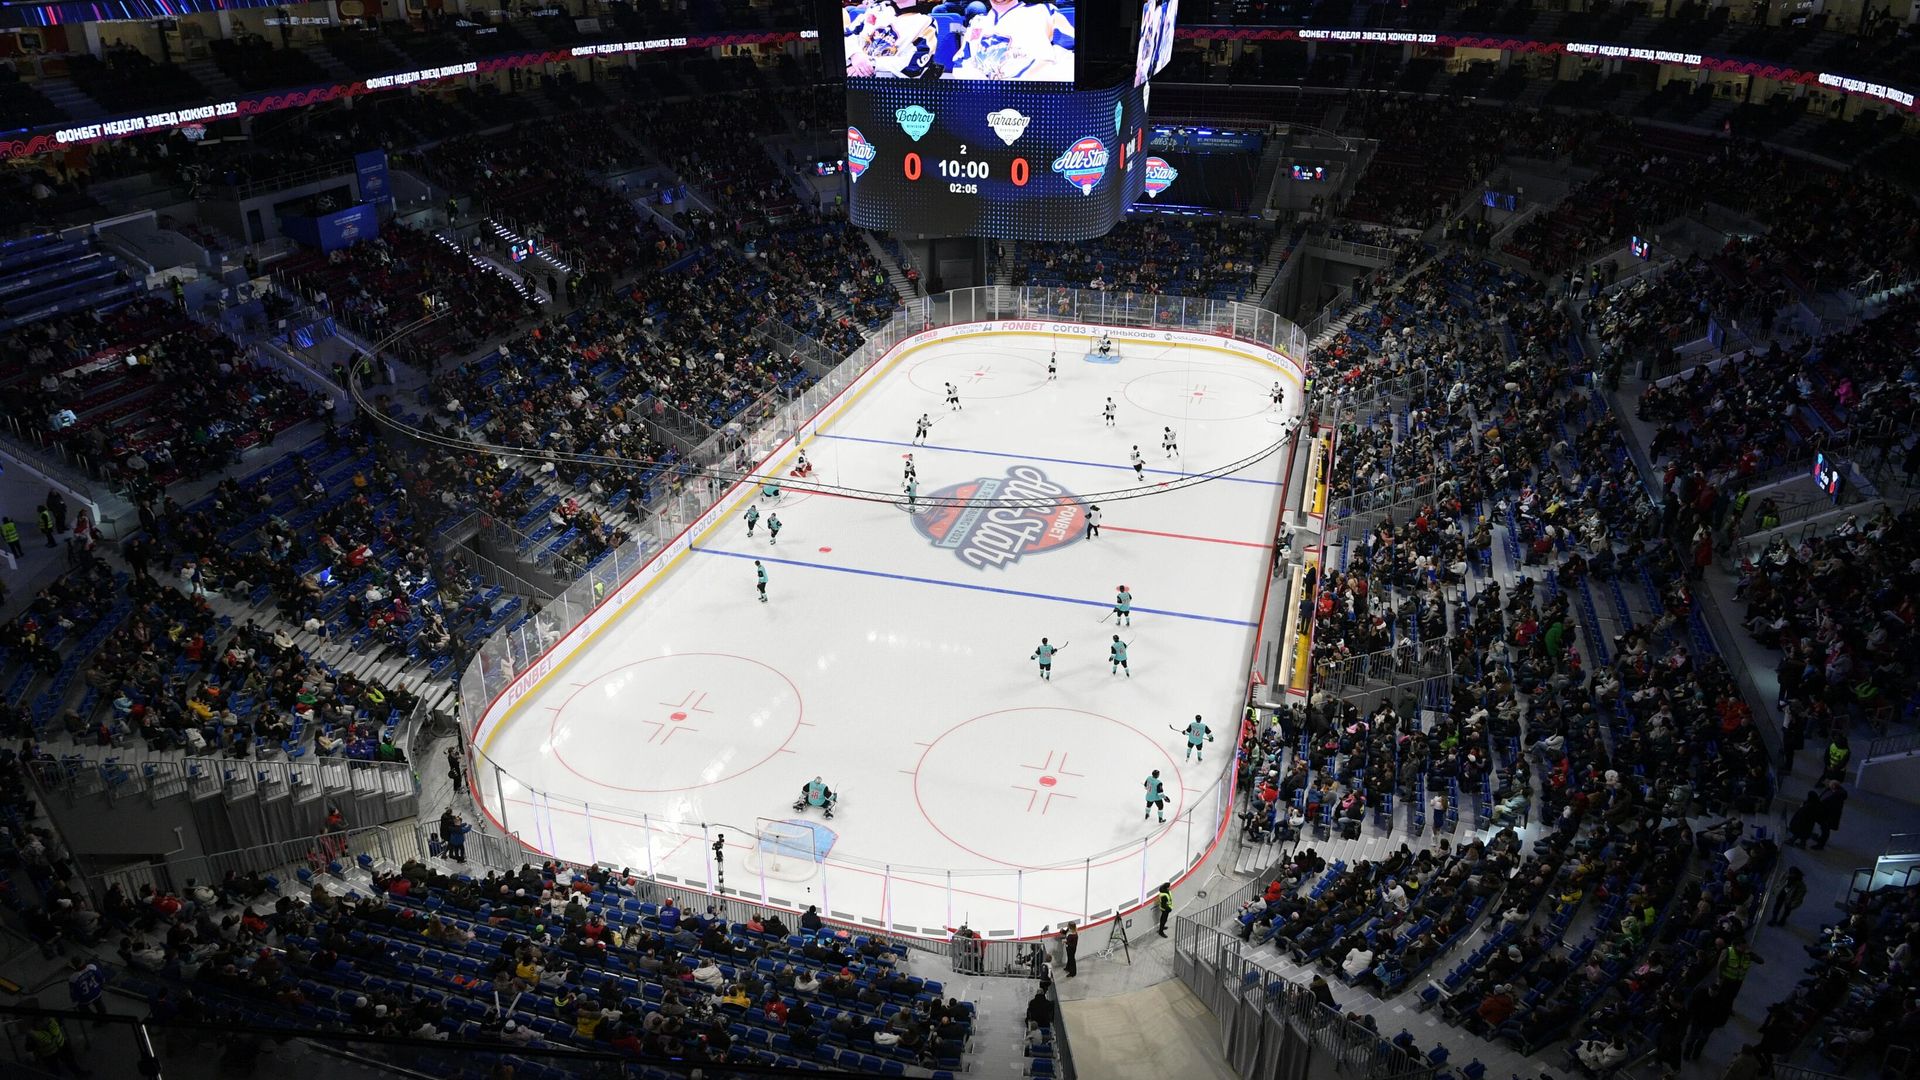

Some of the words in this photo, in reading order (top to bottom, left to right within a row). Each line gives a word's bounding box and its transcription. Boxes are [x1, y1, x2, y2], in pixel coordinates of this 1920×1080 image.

[1299, 30, 1330, 38] ФОНБЕТ
[1331, 31, 1360, 40] НЕДЕЛЯ
[1362, 32, 1386, 41] ЗВЕЗД
[1387, 32, 1417, 42] ХОККЕЯ
[1418, 34, 1436, 42] 2023
[571, 46, 596, 56] ФОНБЕТ
[597, 43, 623, 53] НЕДЕЛЯ
[624, 41, 644, 51] ЗВЕЗД
[644, 39, 670, 48] ХОККЕЯ
[670, 38, 687, 46] 2023
[1567, 43, 1598, 54] ФОНБЕТ
[1599, 46, 1628, 57] НЕДЕЛЯ
[1630, 48, 1654, 60] ЗВЕЗД
[1655, 50, 1683, 62] ХОККЕЯ
[1684, 54, 1701, 64] 2023
[366, 76, 394, 89] ФОНБЕТ
[394, 71, 420, 84] НЕДЕЛЯ
[420, 68, 440, 80] ЗВЕЗД
[440, 64, 463, 76] ХОККЕЯ
[463, 62, 477, 72] 2023
[1818, 72, 1843, 87] ФОНБЕТ
[1842, 78, 1866, 92] НЕДЕЛЯ
[1866, 82, 1886, 98] ЗВЕЗД
[56, 124, 102, 143] ФОНБЕТ
[104, 118, 145, 135] НЕДЕЛЯ
[146, 112, 179, 127] ЗВЕЗД
[178, 106, 216, 122] ХОККЕЯ
[216, 102, 237, 115] 2023
[897, 110, 933, 122] Bobrov
[989, 114, 1028, 126] Tarasov
[960, 145, 966, 154] 2
[1055, 149, 1107, 169] All-Star
[904, 153, 921, 180] 0
[938, 160, 990, 178] 10:00
[1011, 158, 1029, 186] 0
[950, 183, 977, 194] 02:05
[1001, 322, 1046, 331] FONBET
[1053, 324, 1087, 334] согаз
[1104, 329, 1156, 339] ТИНЬКОФФ
[963, 467, 1062, 566] All-Star
[1048, 506, 1076, 541] FONBET
[508, 653, 552, 706] FONBET
